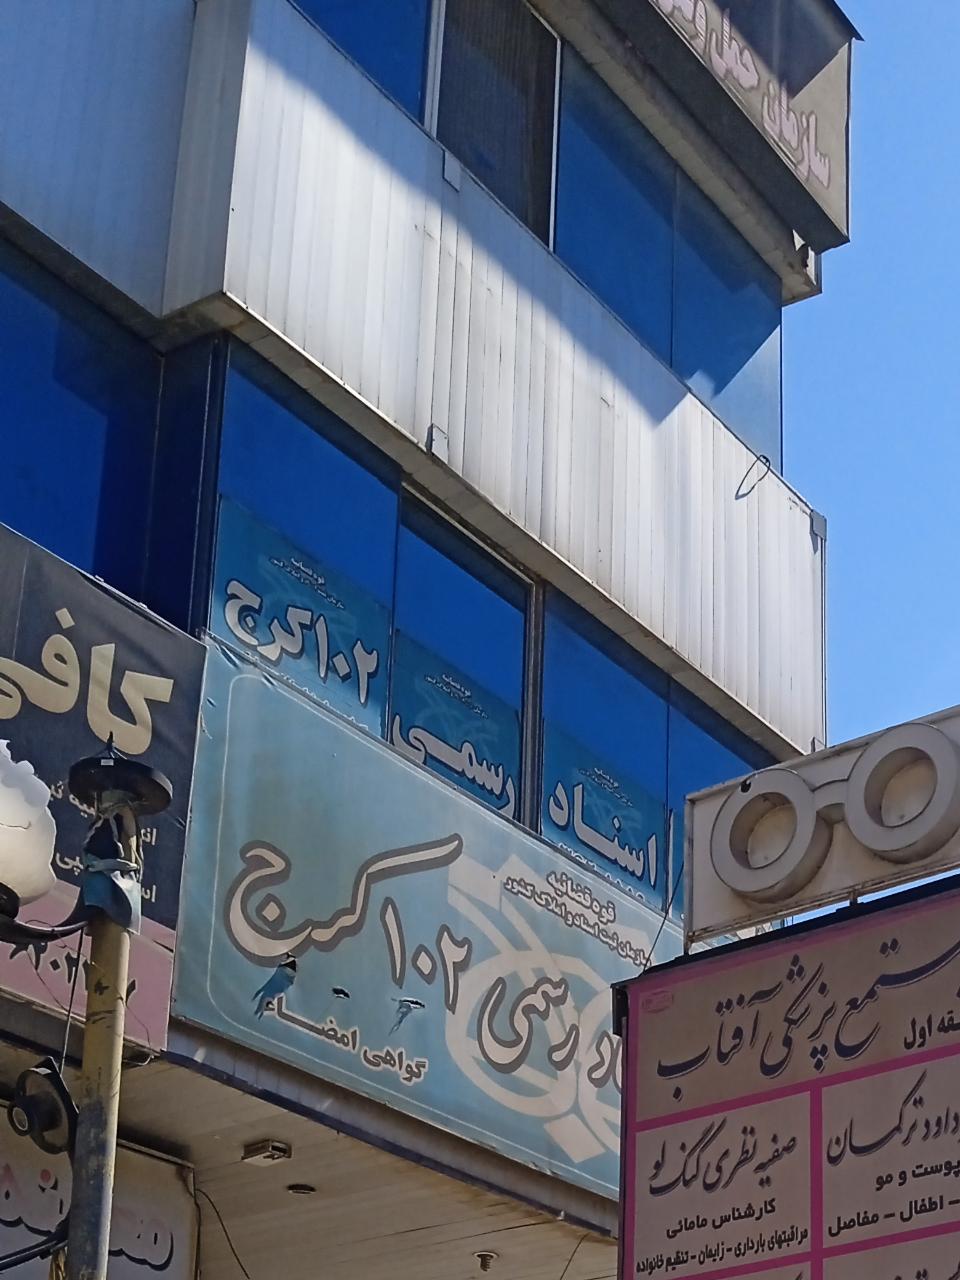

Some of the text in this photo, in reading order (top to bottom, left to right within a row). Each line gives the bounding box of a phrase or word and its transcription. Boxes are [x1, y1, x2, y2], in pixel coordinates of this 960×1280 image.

[224, 579, 313, 662] کرج
[314, 614, 378, 704] ۱۰۲
[391, 713, 517, 817] رسمی
[547, 782, 657, 888] اسناد
[226, 833, 463, 958] کرج
[504, 876, 535, 900] کشور
[573, 915, 599, 938] اسناد
[591, 900, 616, 925] قوه
[380, 896, 472, 1015] ۱۰۲
[478, 978, 579, 1072] رسمی
[759, 953, 837, 1080] پزشکی
[903, 1015, 933, 1051] اول
[264, 997, 427, 1083] گواهی امضاء
[656, 980, 784, 1102] آفتاب
[921, 1106, 960, 1142] داود
[702, 1125, 758, 1193] نظری
[753, 1133, 797, 1188] صفیه
[875, 1173, 894, 1192] مو
[898, 1170, 908, 1187] و
[666, 1198, 776, 1239] کارشناس مامائی
[828, 1210, 880, 1237] مفاصل
[900, 1195, 944, 1223] اطفال
[698, 1241, 725, 1265] زایمان
[734, 1232, 766, 1257] بارداری
[767, 1225, 808, 1251] مراقبتهای
[636, 1254, 664, 1275] خانواده
[665, 1251, 689, 1272] تنظیم
